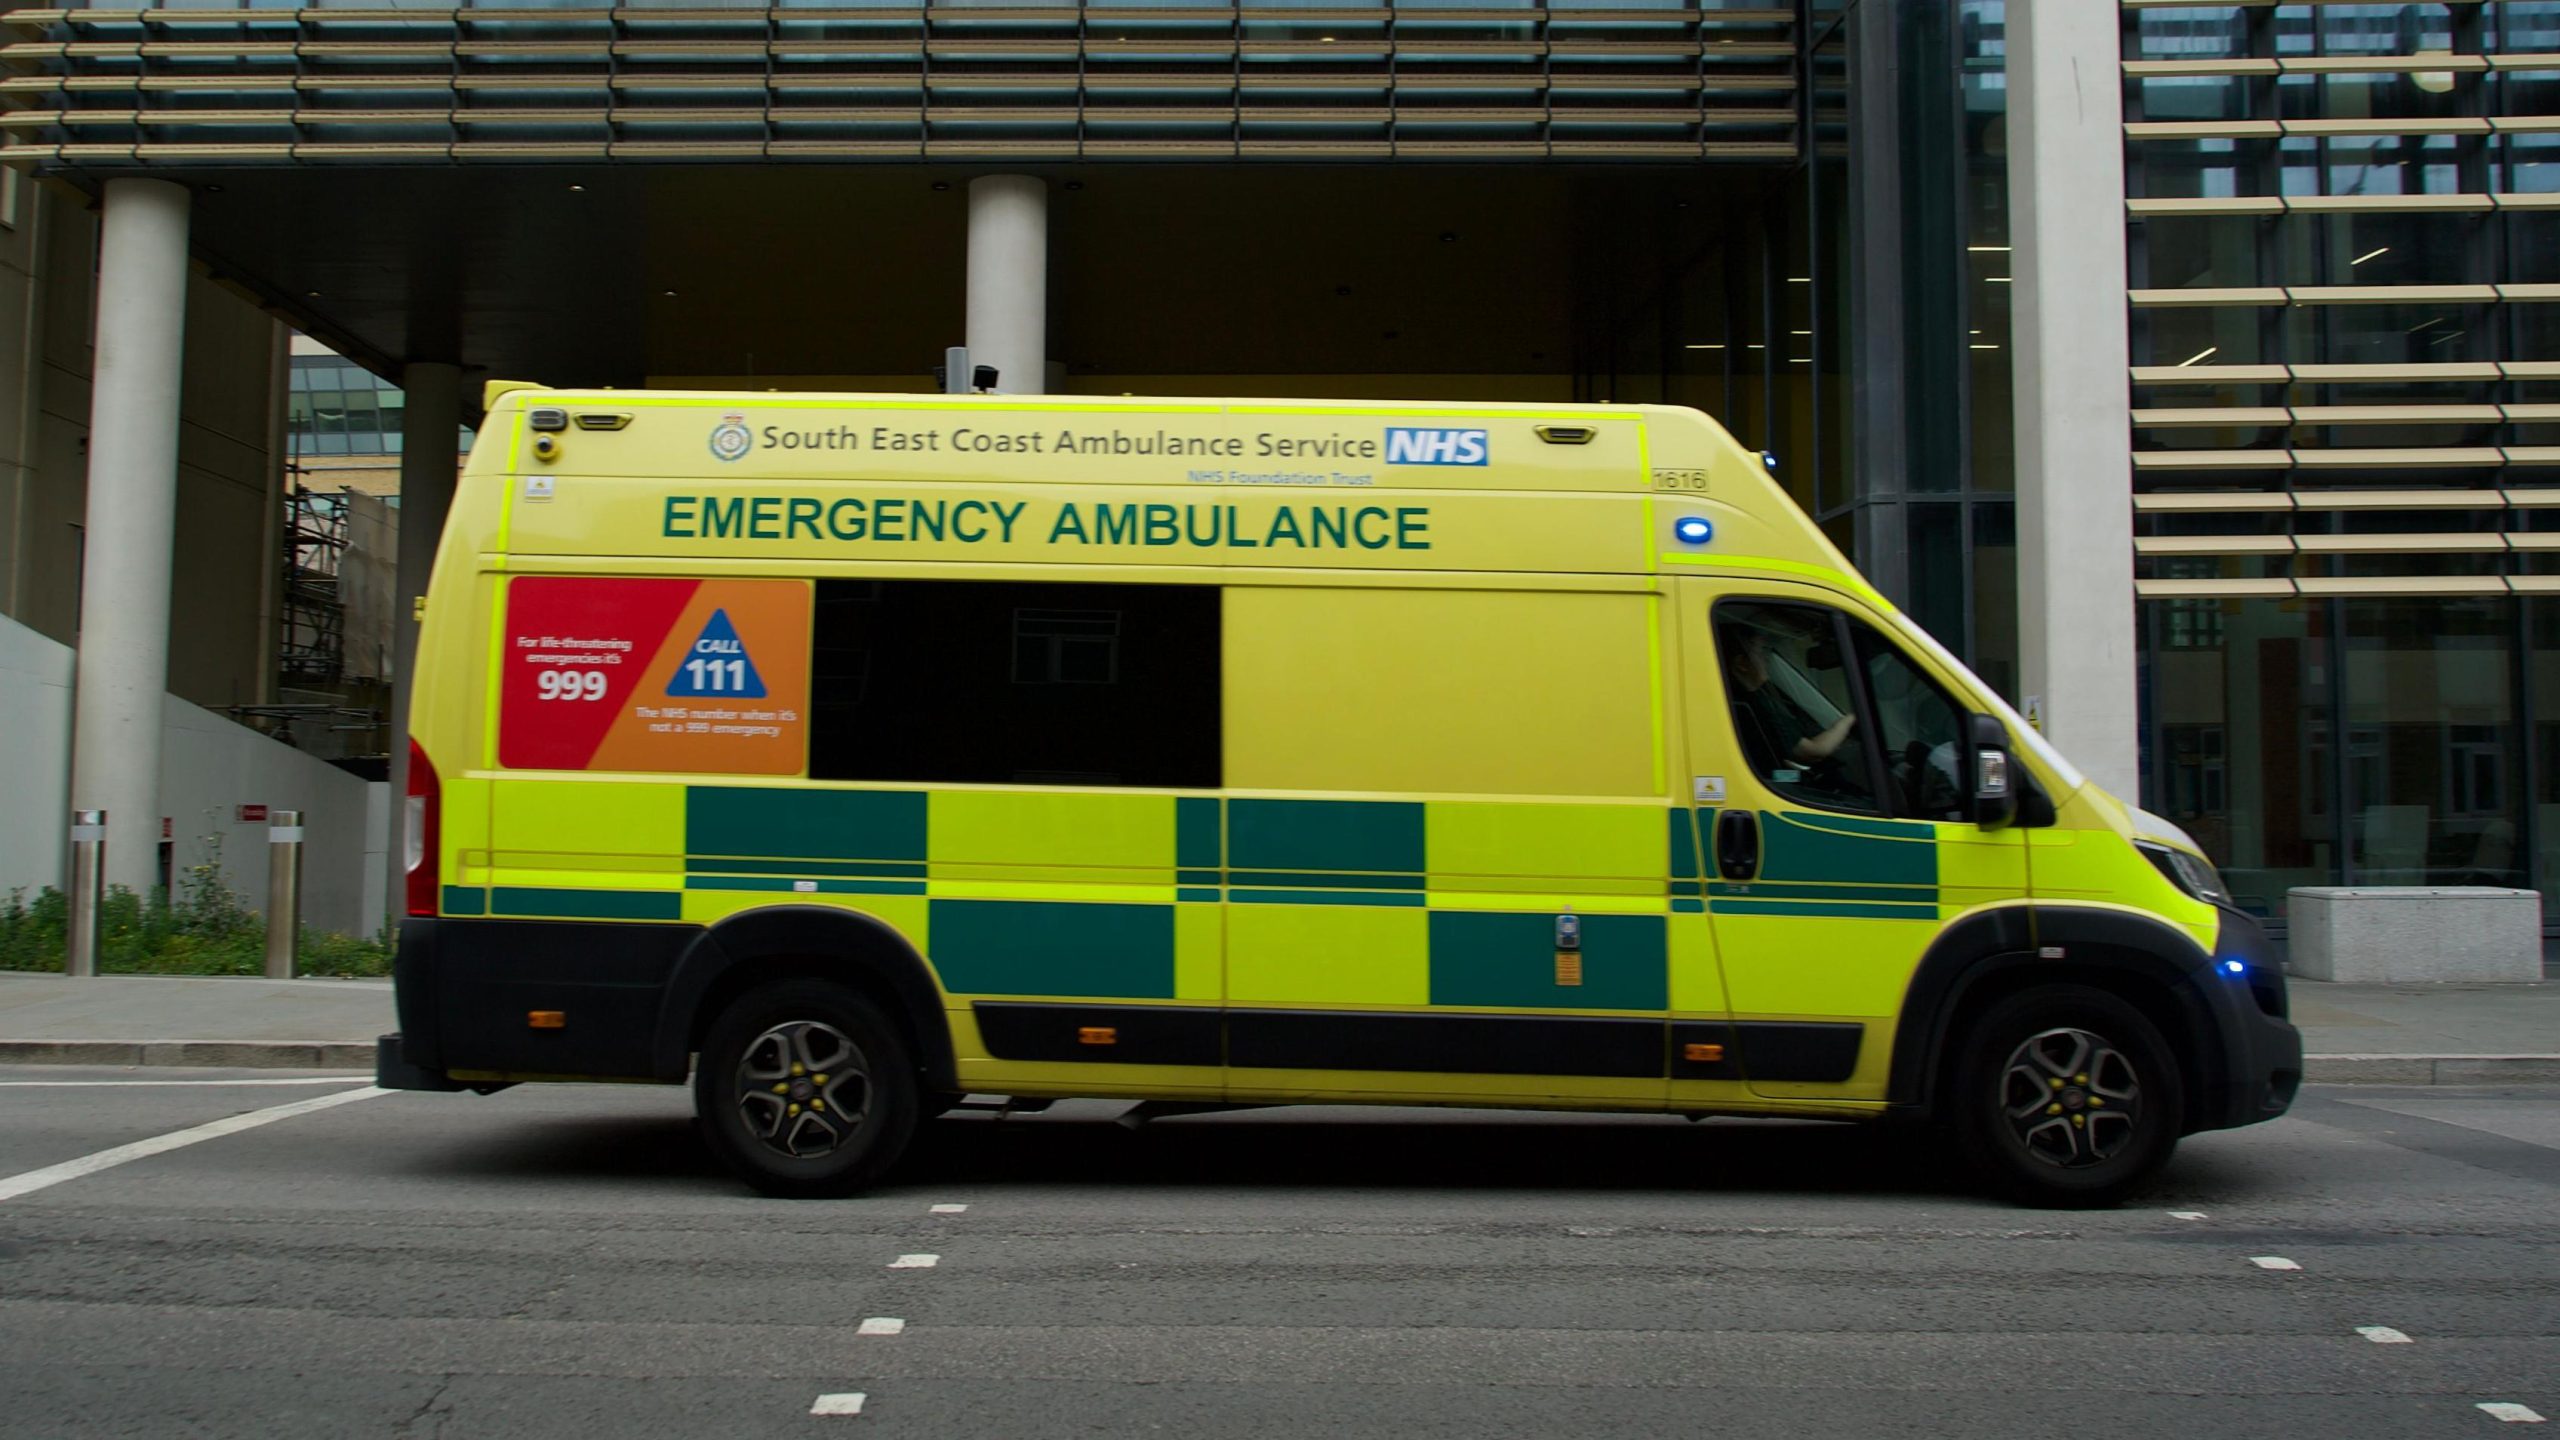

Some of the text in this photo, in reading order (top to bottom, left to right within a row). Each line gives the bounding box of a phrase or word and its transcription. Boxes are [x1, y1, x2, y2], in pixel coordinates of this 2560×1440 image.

[762, 425, 1377, 459] South East Coast Ambulance Service
[1387, 430, 1487, 464] NHS
[1187, 470, 1373, 486] NHS Foundation Trust
[1653, 471, 1706, 489] 1616
[662, 496, 1431, 550] EMERGENCY AMBULANCE
[695, 639, 742, 654] CALL
[537, 670, 608, 701] 999
[685, 659, 746, 691] 111
